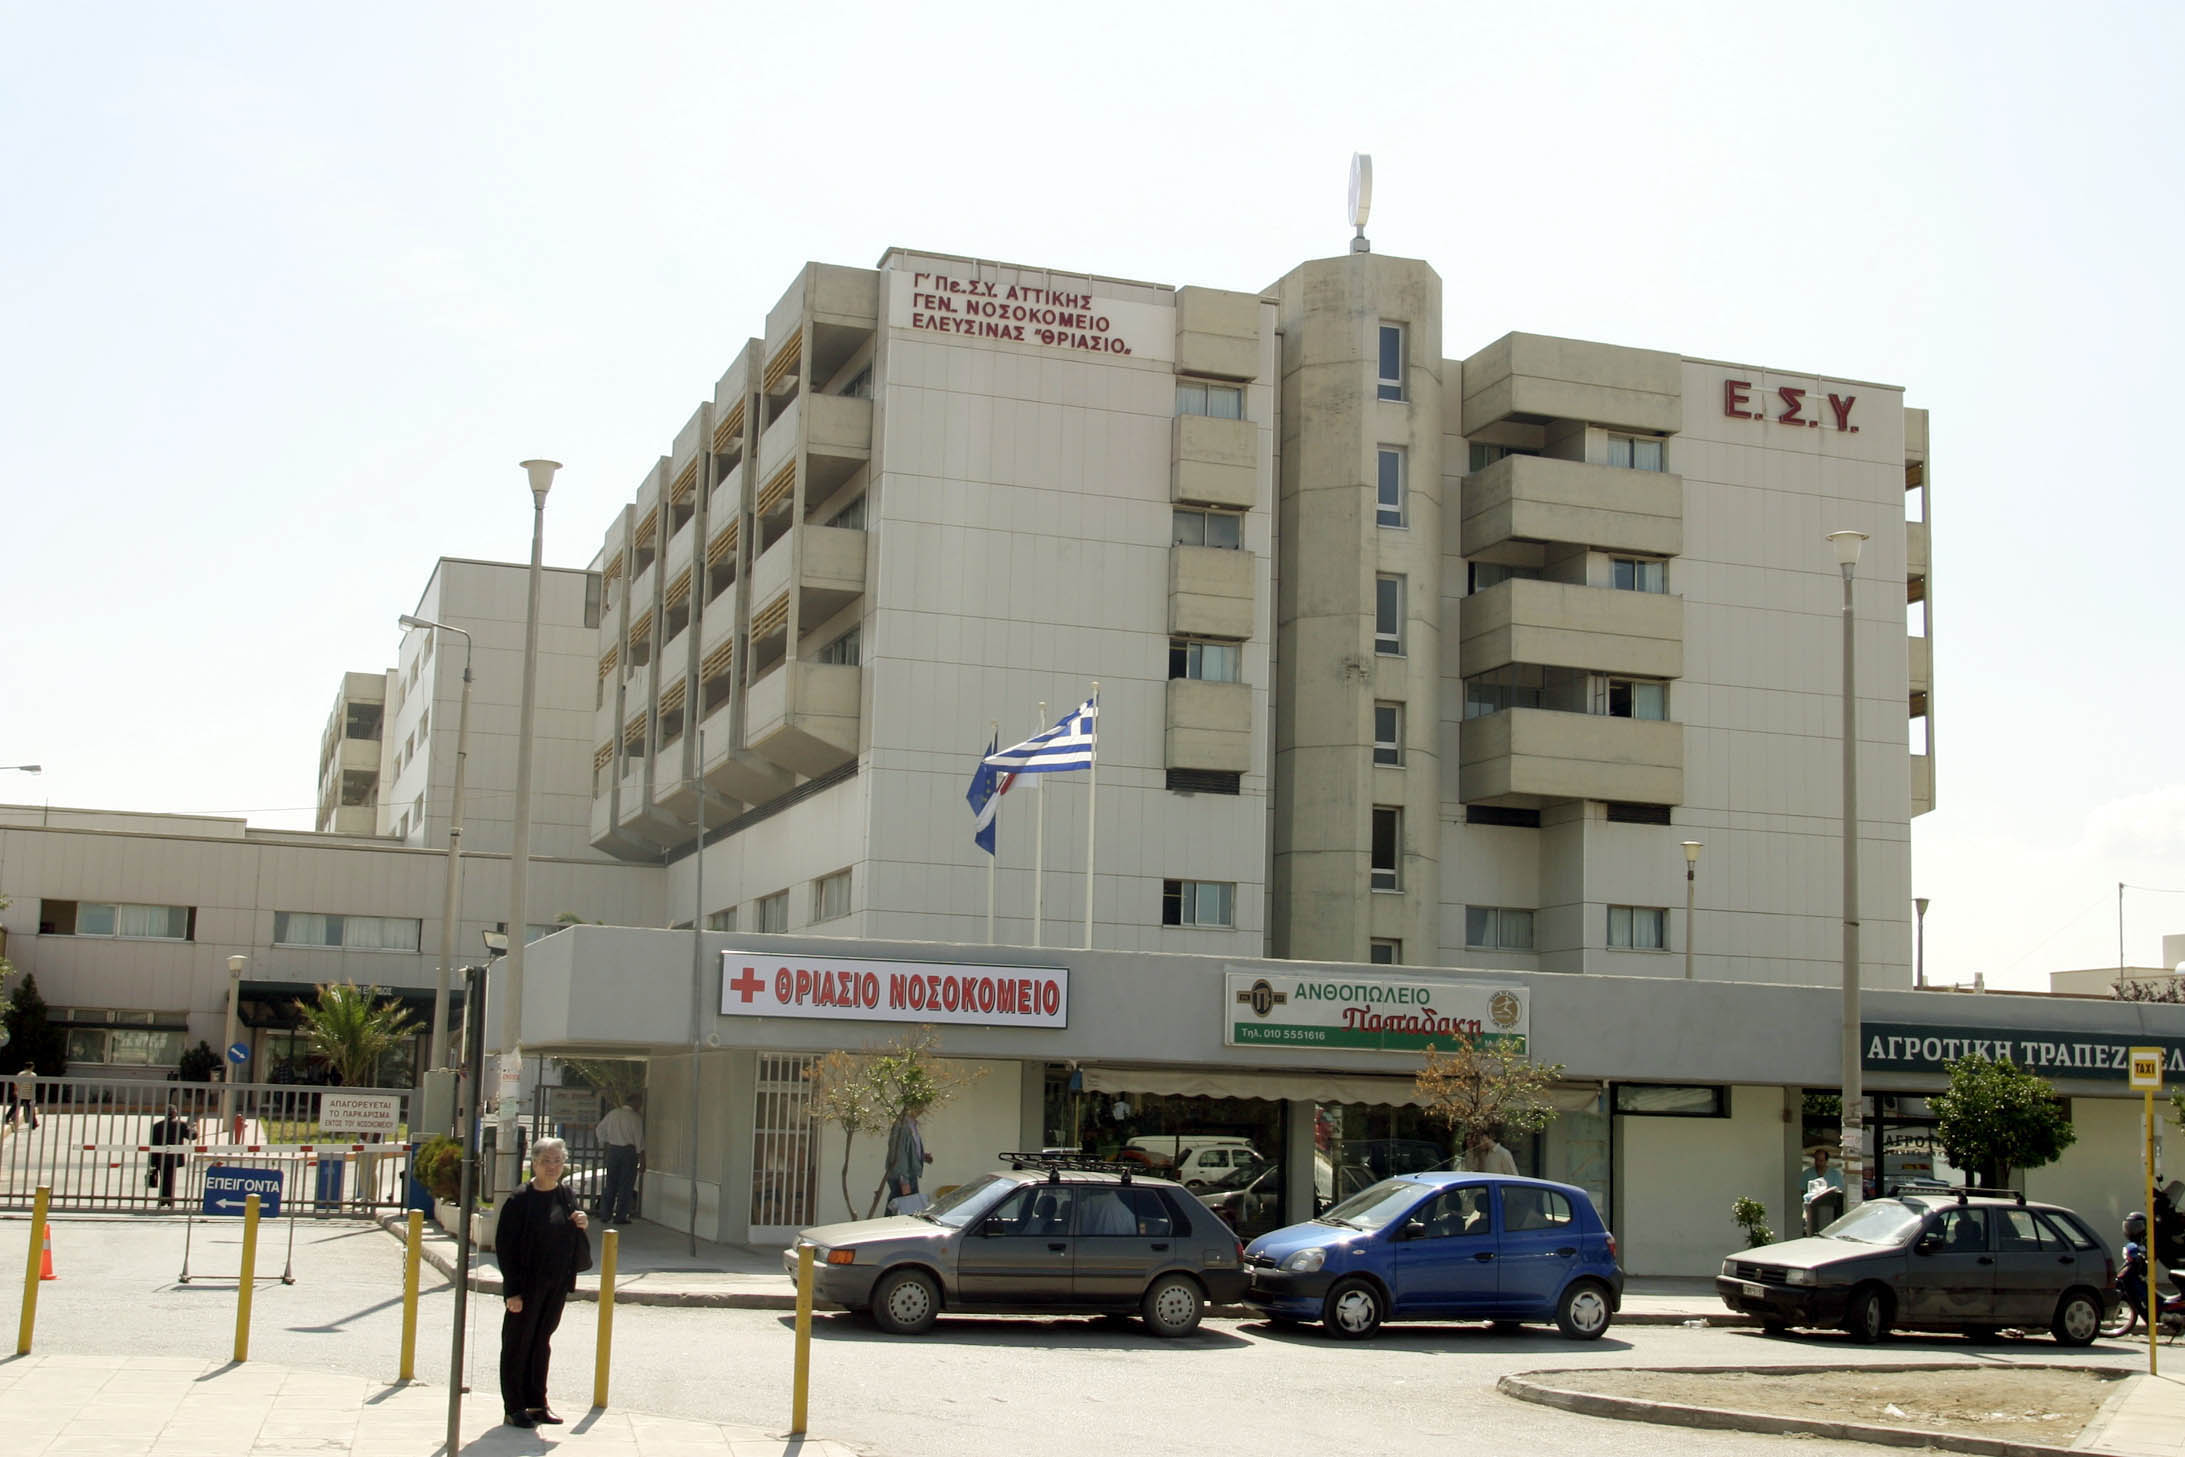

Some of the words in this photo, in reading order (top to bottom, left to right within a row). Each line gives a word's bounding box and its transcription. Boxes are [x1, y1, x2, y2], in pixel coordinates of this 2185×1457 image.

[1006, 285, 1092, 311] ΑΤΤΙΚΗΣ
[913, 292, 958, 313] ΓΕΝ.
[966, 299, 1110, 332] ΝΟΣΟΚΟΜΕΙΟ
[912, 313, 1026, 341] ΕΛΕΥΣΙΝΑΣ
[1725, 379, 1860, 433] Ε.Σ.Υ.
[774, 967, 880, 1009] ΘΡΙΑΣΙΟ
[889, 973, 1061, 1016] ΝΟΣΟΚΟΜΕΙΟ
[1294, 983, 1431, 1006] ΑΝΘΟΠΩΛΕΙΟ
[1241, 1028, 1262, 1039] Τηλ.
[1264, 1029, 1281, 1039] 010
[1283, 1030, 1326, 1041] 5551616
[1867, 1035, 2013, 1065] ΑΓΡΟΤΙΚΗ
[2021, 1041, 2129, 1070] ΤΡΑΠΕΖ
[2135, 1063, 2155, 1075] TAXI
[329, 1100, 392, 1109] ΑΠΑΓΟΡΕΥΕΤΑΙ
[329, 1110, 340, 1118] ΤΟ
[206, 1177, 281, 1193] ΕΠΕΙΓΟΝΤΑ
